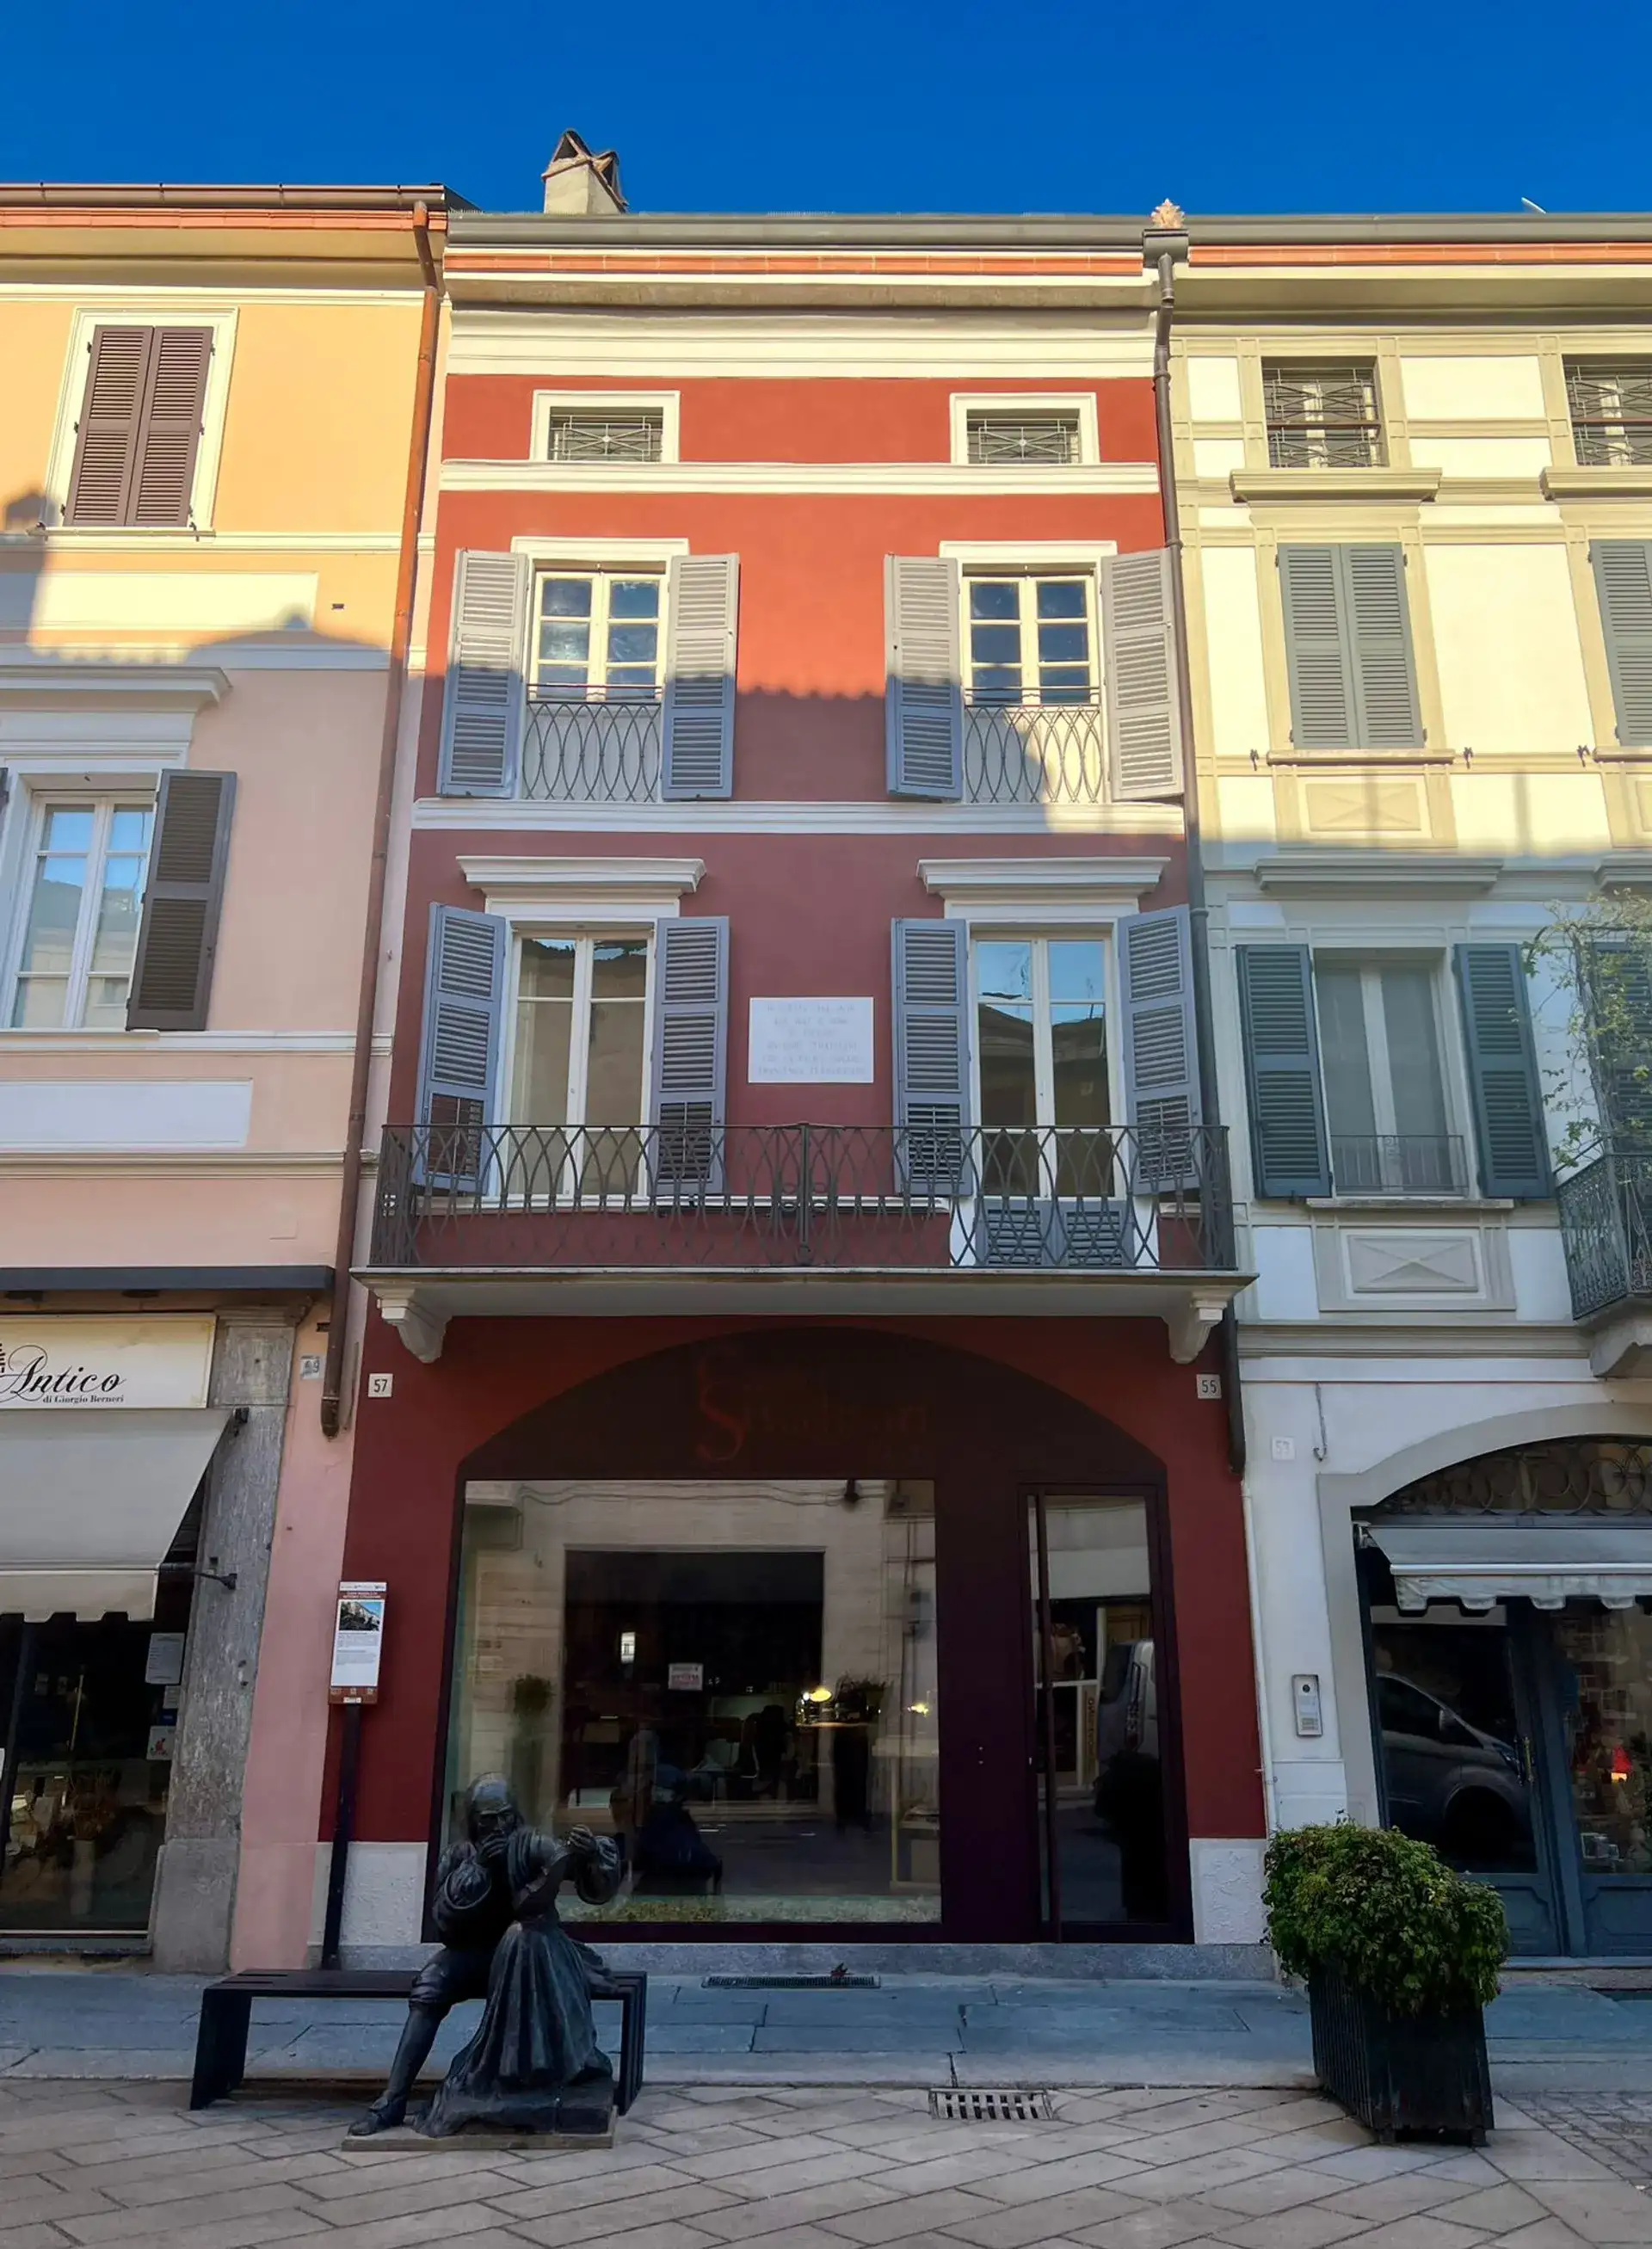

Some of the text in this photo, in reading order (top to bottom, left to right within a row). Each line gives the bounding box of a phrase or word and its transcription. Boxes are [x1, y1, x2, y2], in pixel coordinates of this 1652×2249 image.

[0, 1344, 126, 1402] Antico
[373, 1378, 388, 1393] 57
[1201, 1379, 1217, 1394] 55
[43, 1395, 124, 1404] di Giorgio Berneri
